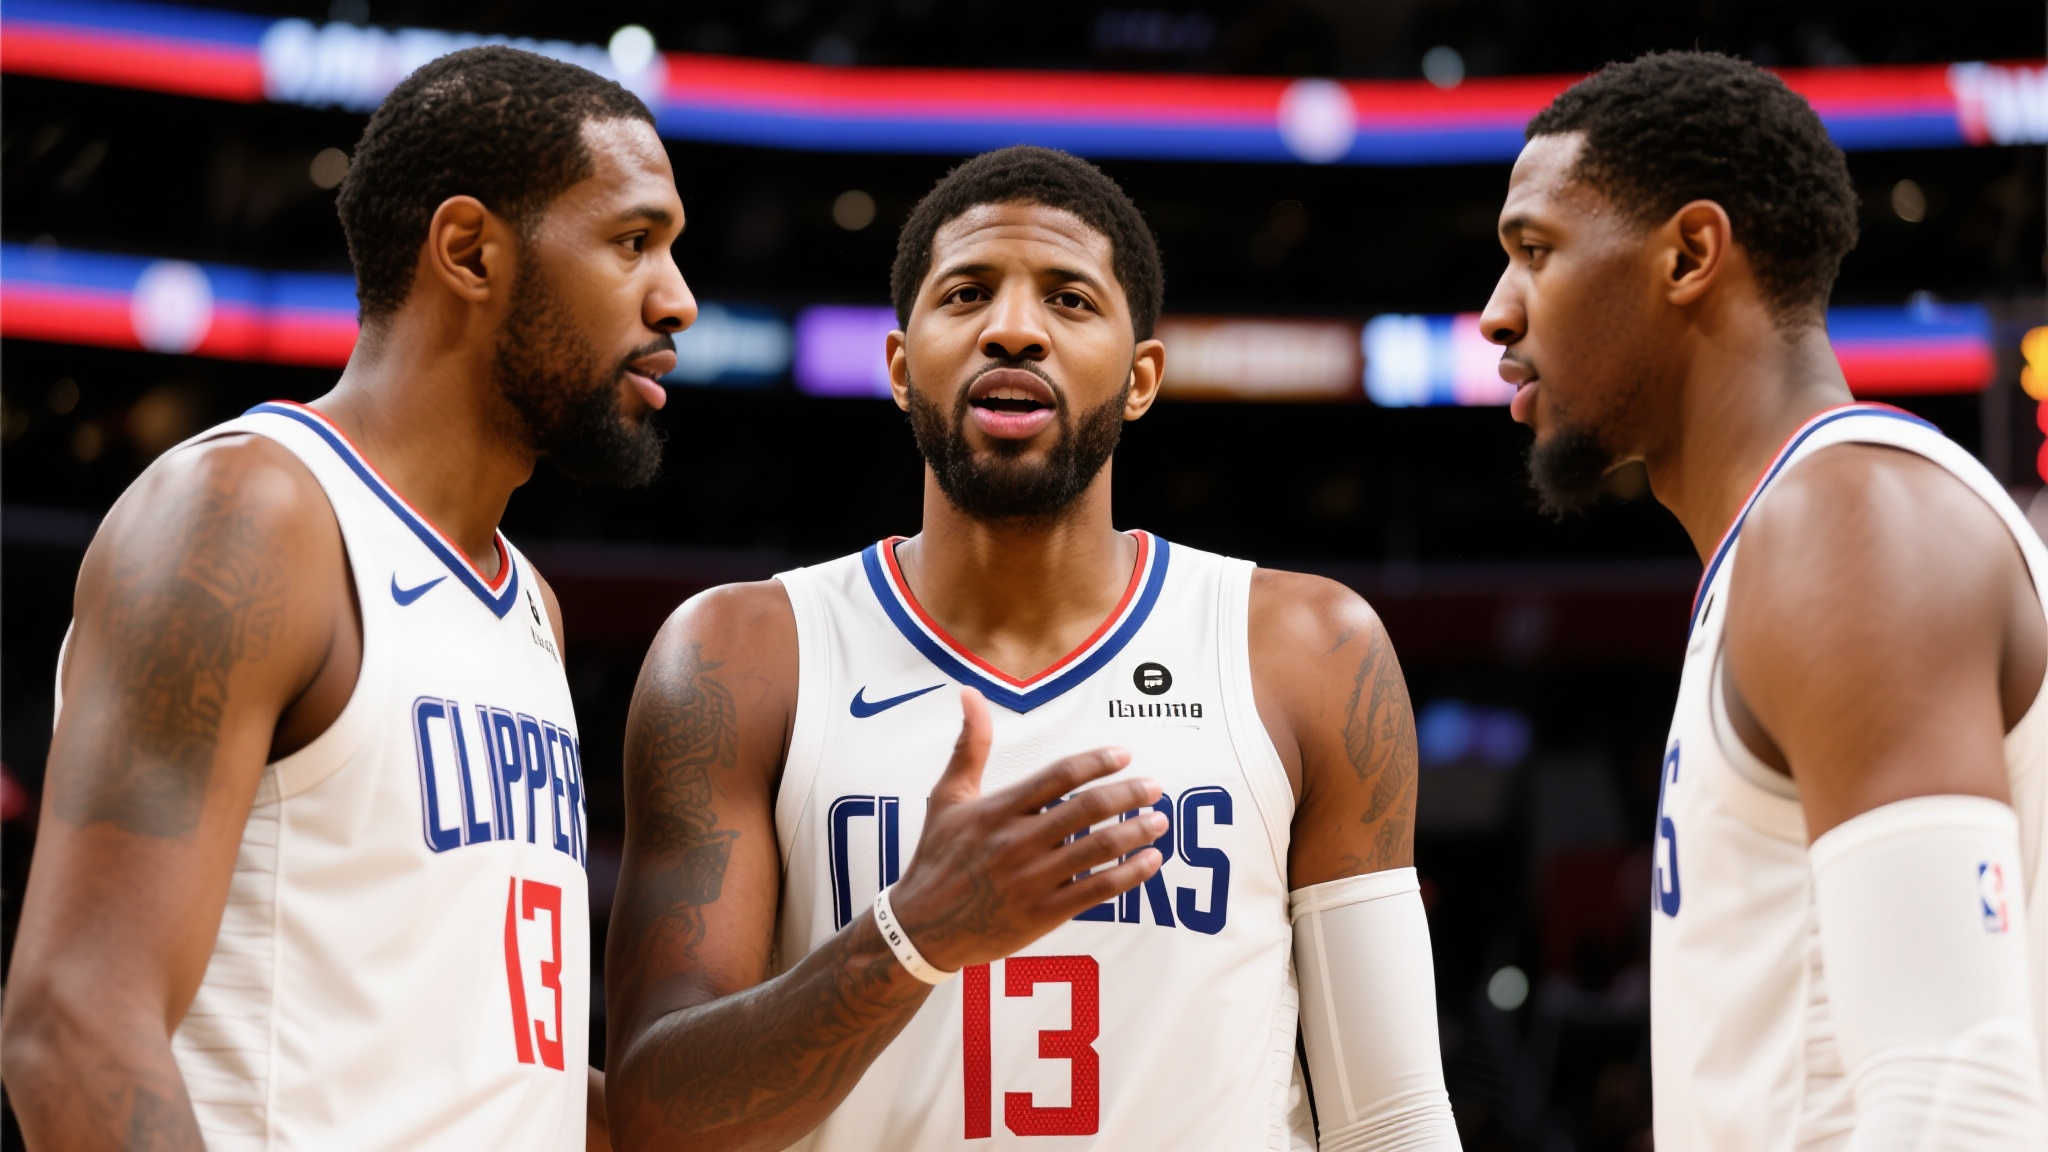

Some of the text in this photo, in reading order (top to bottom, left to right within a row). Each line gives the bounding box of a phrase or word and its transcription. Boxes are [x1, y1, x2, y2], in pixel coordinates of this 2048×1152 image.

[412, 696, 588, 869] CLIPPER
[504, 876, 565, 1071] 13
[963, 955, 1099, 1139] 13
